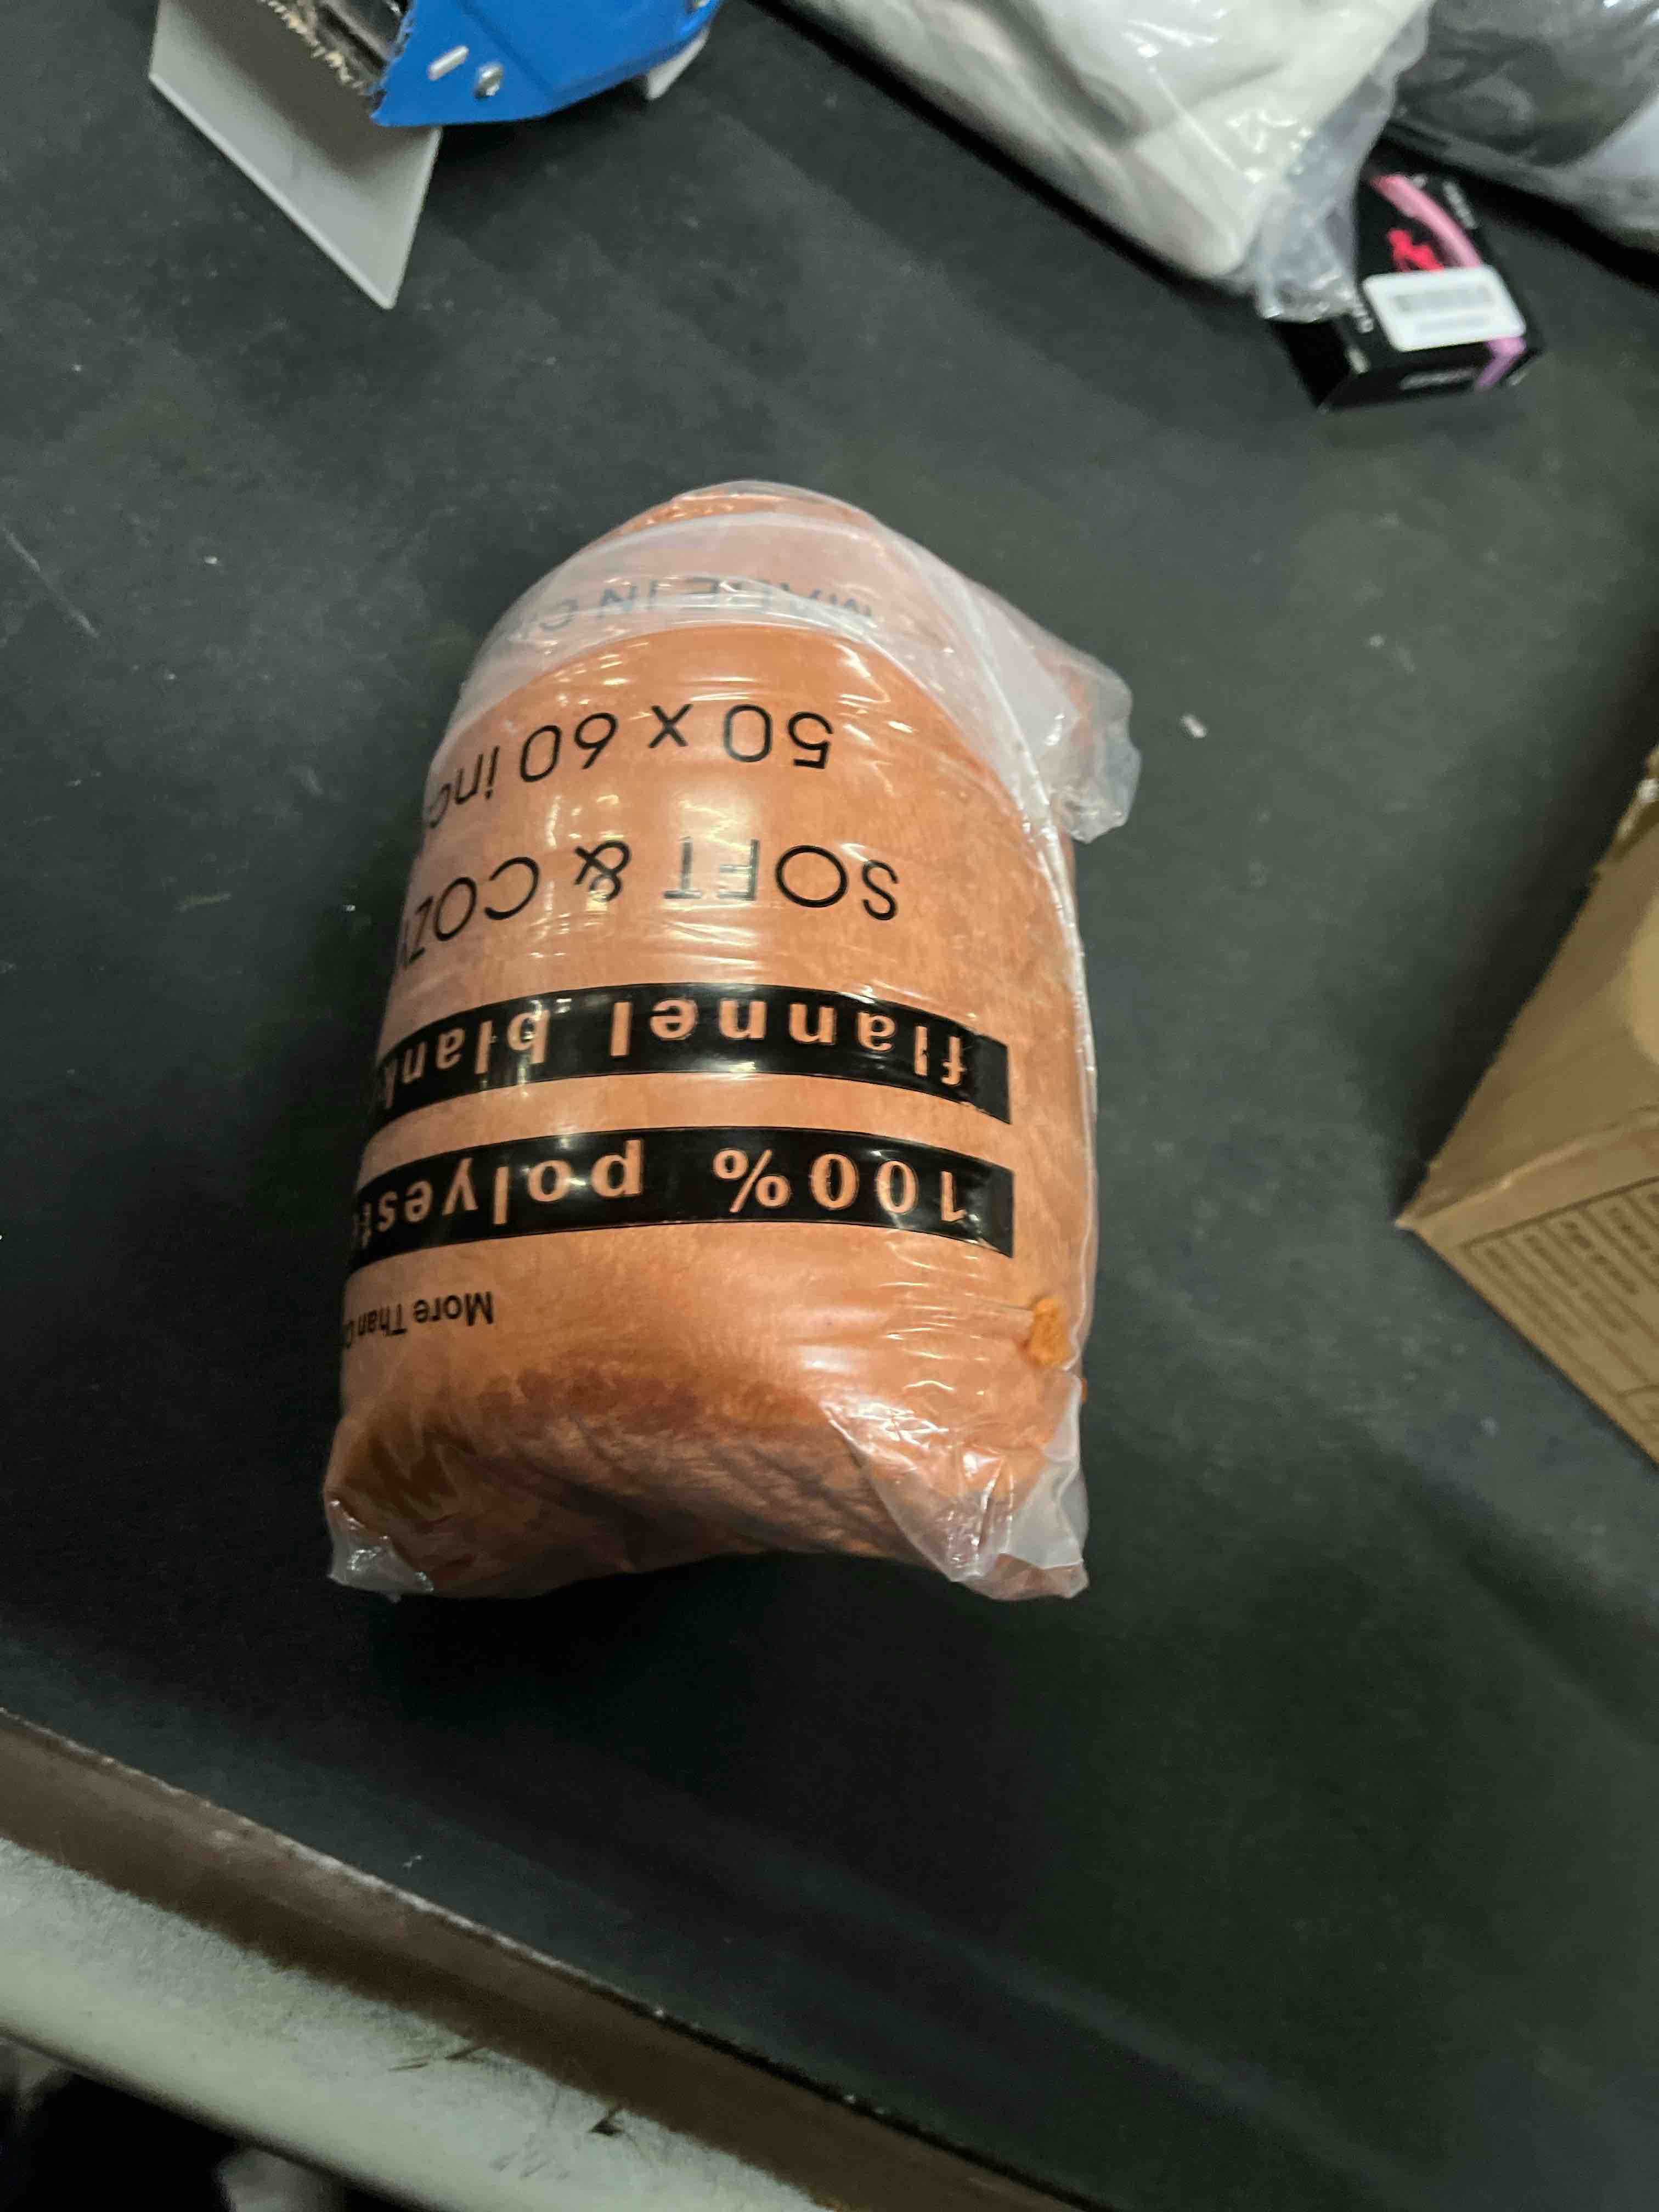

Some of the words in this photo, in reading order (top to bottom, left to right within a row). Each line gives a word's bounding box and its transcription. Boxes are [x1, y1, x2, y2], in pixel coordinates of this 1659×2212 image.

[520, 712, 618, 782] 60
[648, 703, 694, 748] x
[723, 703, 834, 769] 50
[574, 840, 631, 902] &
[663, 836, 898, 921] SOFT
[610, 997, 967, 1086] flannel
[713, 1149, 966, 1222] 100%
[358, 1303, 407, 1337] Than
[413, 1291, 494, 1326] More
